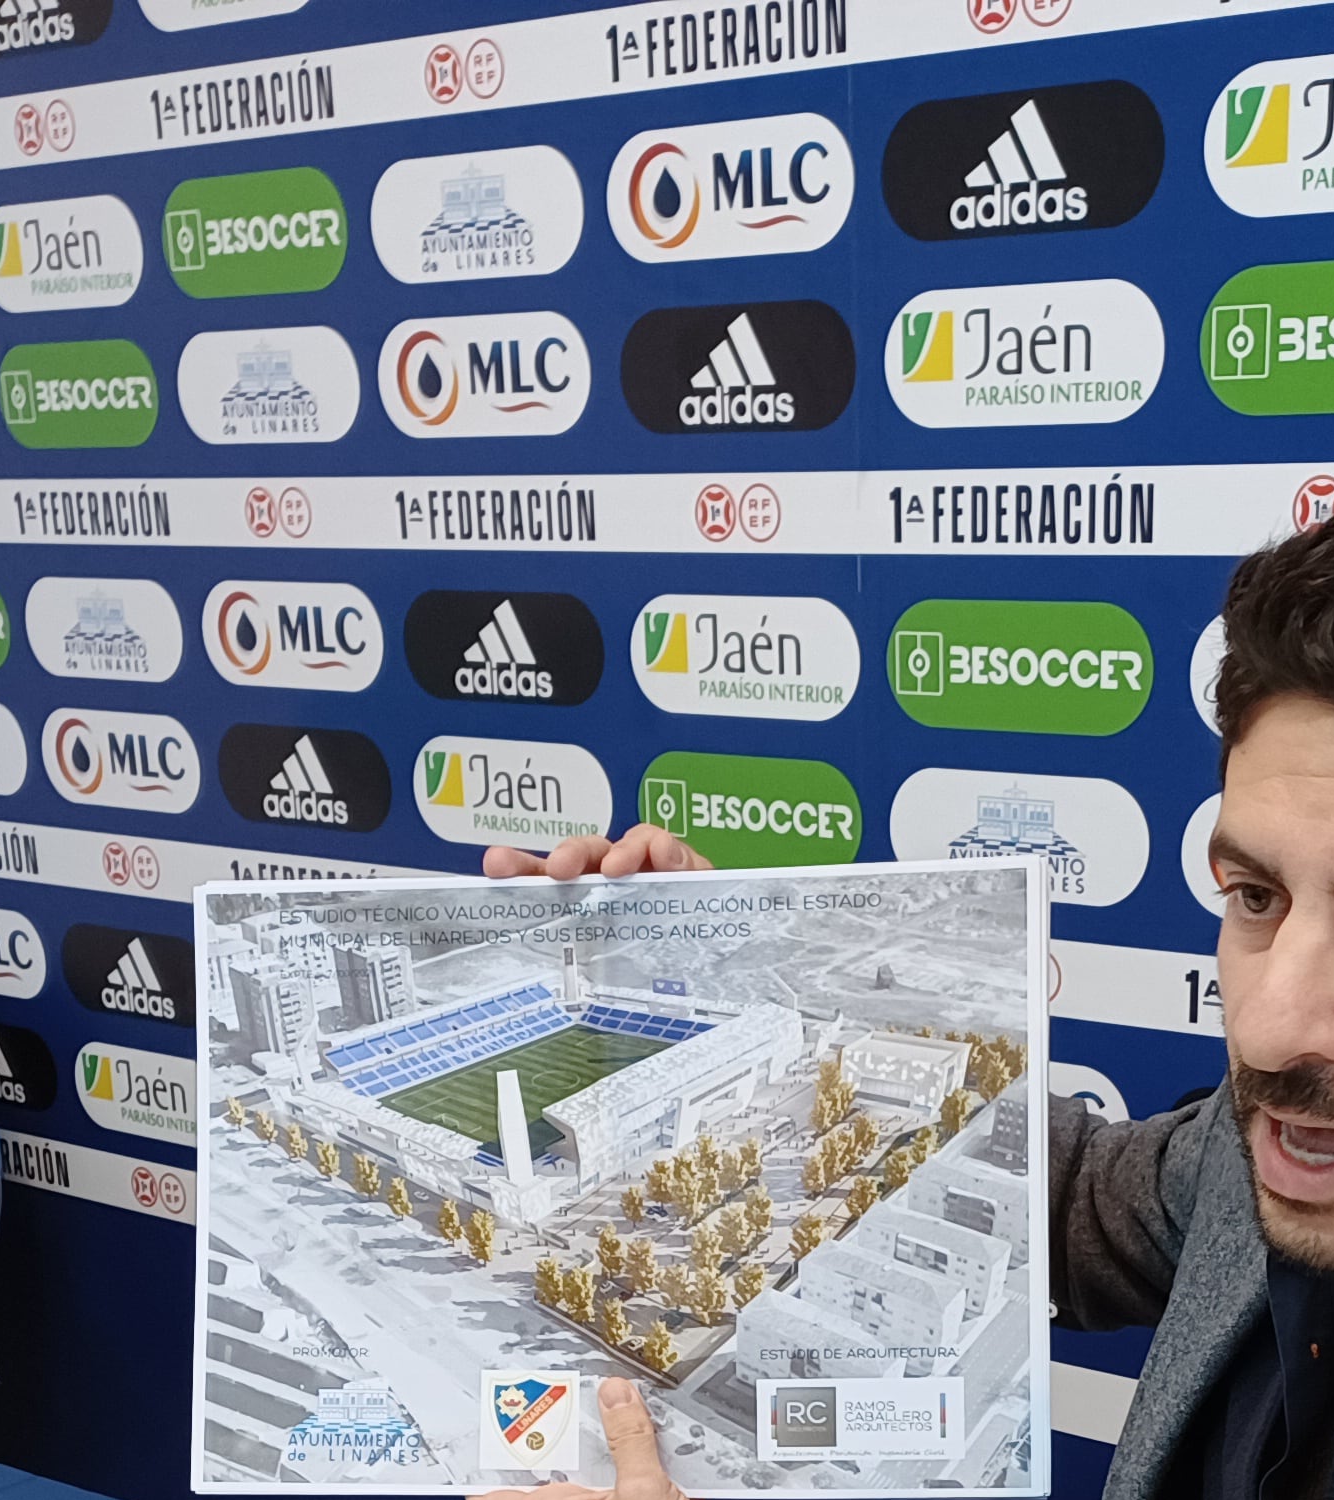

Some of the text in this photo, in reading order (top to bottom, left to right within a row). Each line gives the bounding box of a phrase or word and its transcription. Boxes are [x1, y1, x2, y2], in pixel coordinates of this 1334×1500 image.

[179, 60, 335, 136] FEDERACIÓN
[712, 141, 830, 211] MLC
[949, 181, 1088, 230] adidas
[24, 217, 102, 275] Jaén
[206, 209, 341, 255] BESOCCER
[421, 230, 533, 255] AYUNTAMIENTO
[456, 247, 535, 271] LINARES
[963, 305, 1091, 380] Jaén
[468, 336, 570, 393] MLC
[37, 377, 152, 411] BESOCCER
[222, 401, 317, 421] AYUNTAMIENTO
[679, 386, 795, 426] adidas
[966, 379, 1143, 408] PARAÍSO INTERIOR
[252, 417, 319, 434] LINARES
[39, 487, 171, 537] FEDERACIÓN
[429, 481, 595, 543] FEDERACIÓN
[933, 474, 1155, 544] FEDERACIÓN
[279, 606, 366, 656] MLC
[695, 612, 801, 676] Jaén
[455, 663, 552, 698] adidas
[949, 646, 1142, 691] BESOCCER
[699, 678, 843, 705] PARAÍSO INTERIOR
[109, 732, 186, 781] MLC
[469, 754, 563, 813] Jaén
[263, 788, 349, 824] adidas
[691, 793, 852, 841] BESOCCER
[474, 814, 530, 836] PARAÍSO
[280, 893, 881, 924] ESTUDIO TÉCNICO VALORADO PARA REMODELACIÓN DEL ESTADO
[280, 931, 375, 947] MUNICIPAL
[380, 931, 403, 946] DE
[410, 929, 512, 946] LINAREJOS
[518, 929, 528, 943] Y
[533, 927, 571, 943] SUS
[575, 924, 664, 942] ESPACIOS
[101, 986, 175, 1019] adidas
[116, 1059, 187, 1114] Jaén
[761, 1348, 819, 1360] ESTUDIO
[824, 1348, 842, 1360] DE
[516, 1396, 554, 1431] LINARES
[786, 1401, 827, 1425] RC
[844, 1401, 895, 1411] RAMOS
[844, 1411, 932, 1421] CABALLERO
[288, 1433, 420, 1449] AYUNTAMIENTO
[846, 1422, 932, 1432] ARQUITECTOS
[288, 1450, 420, 1463] de LINARES
